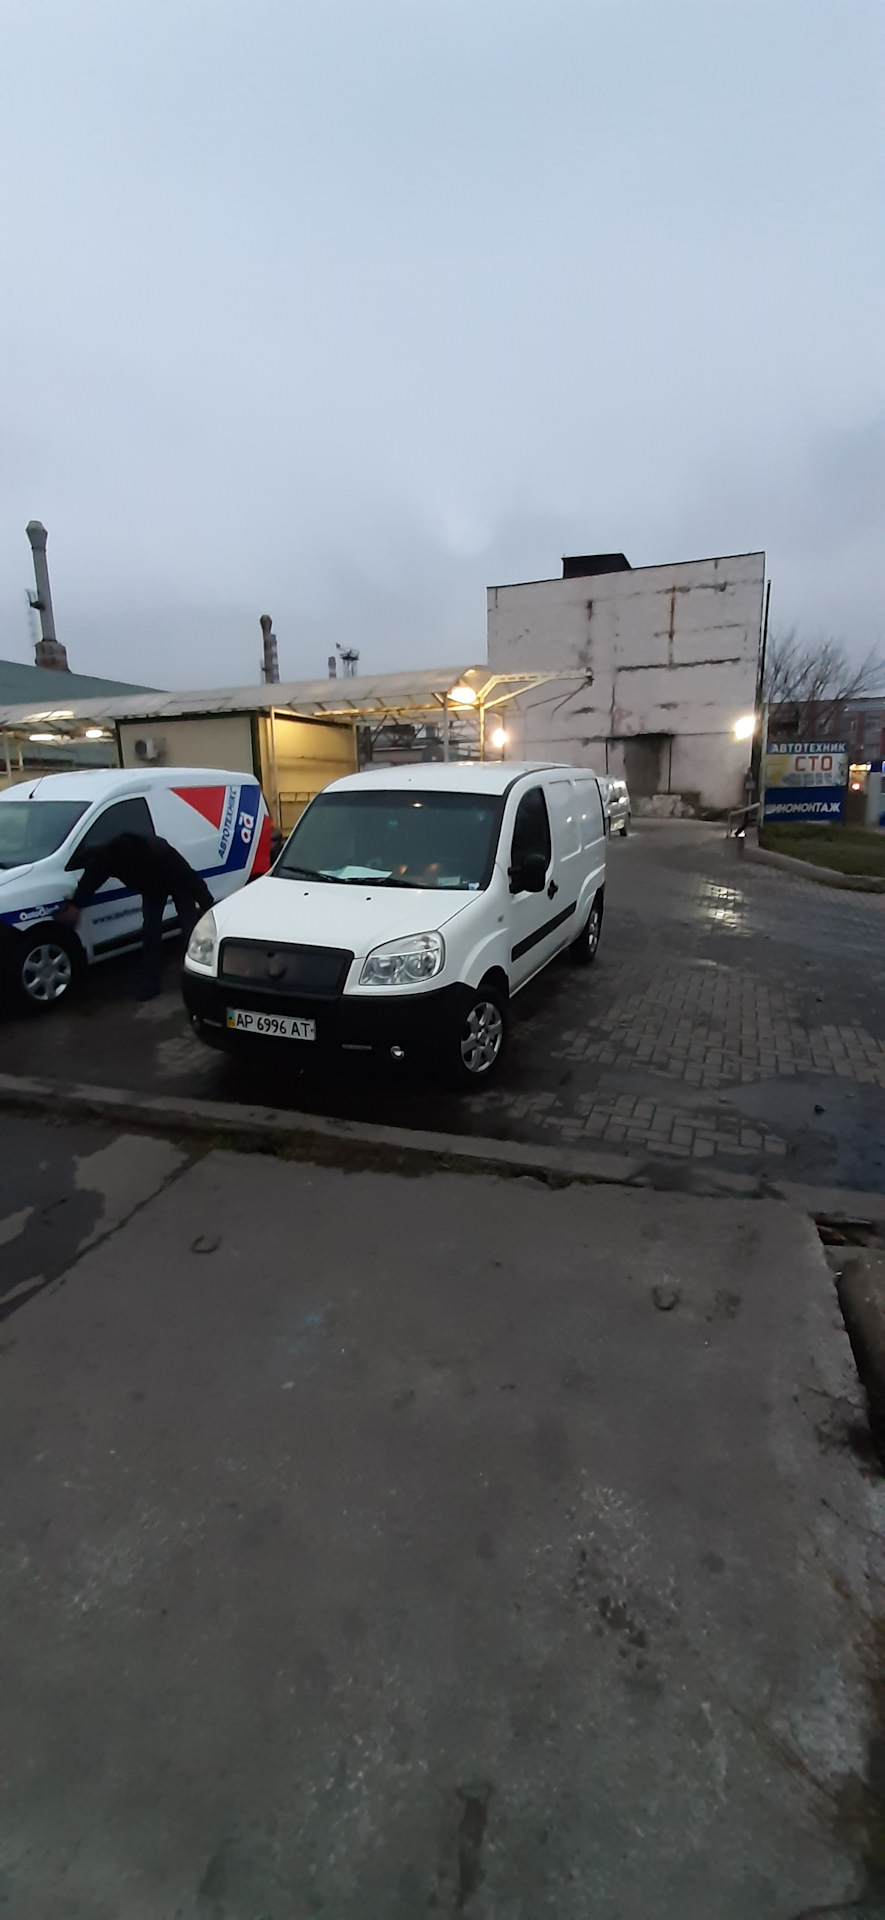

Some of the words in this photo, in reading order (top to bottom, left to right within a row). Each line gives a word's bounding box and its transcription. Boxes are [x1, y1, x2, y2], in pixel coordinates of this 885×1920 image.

[771, 743, 846, 752] АВТОТЕХНИК
[794, 755, 833, 772] СТО
[765, 802, 841, 814] ШИНОМОНТАЖ
[236, 1013, 253, 1028] AP
[257, 1017, 287, 1034] 6996
[291, 1021, 310, 1037] AT
